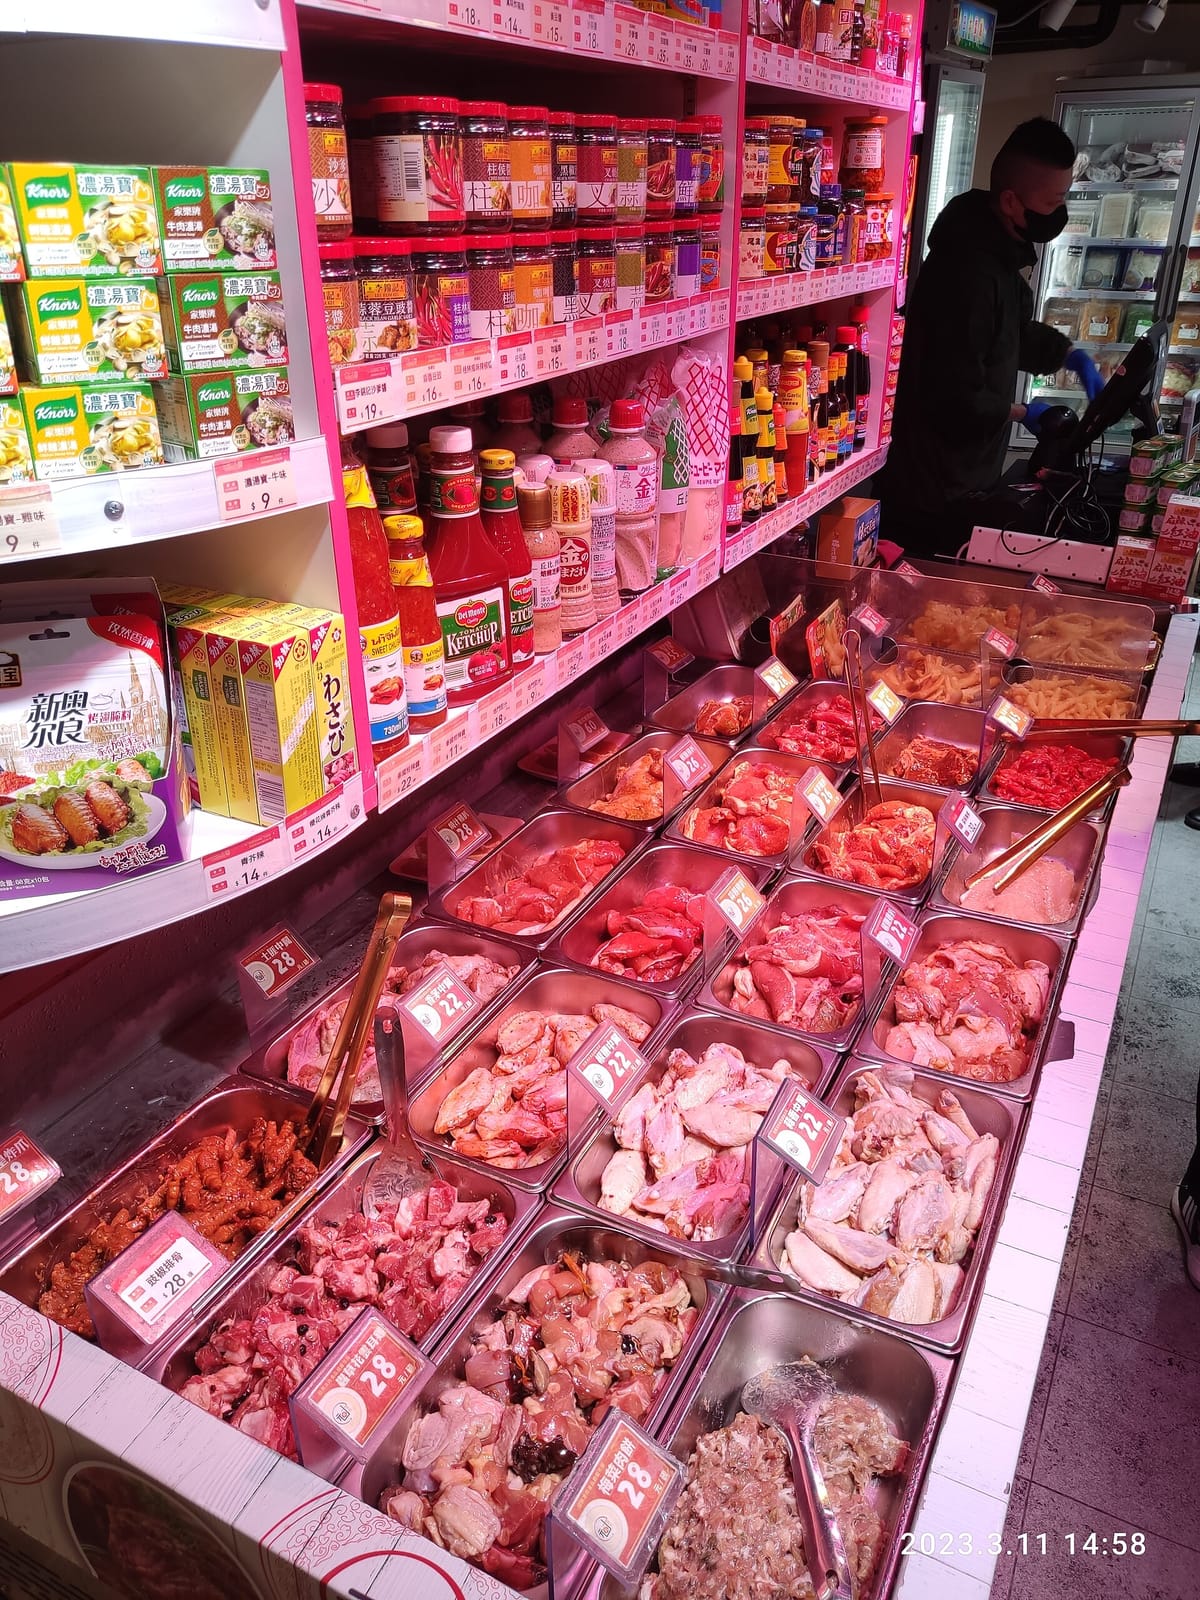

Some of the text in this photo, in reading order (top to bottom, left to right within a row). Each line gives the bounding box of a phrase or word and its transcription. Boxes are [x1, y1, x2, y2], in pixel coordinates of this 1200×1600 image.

[465, 7, 476, 24] 18
[508, 17, 518, 34] 14
[26, 182, 71, 199] Knorr
[79, 174, 135, 195] 濃湯寶
[166, 184, 204, 198] Knorr
[210, 175, 256, 194] 濃湯寶
[182, 289, 218, 302] Knorr
[225, 277, 268, 296] 濃湯寶
[38, 297, 80, 312] Knorr
[88, 287, 142, 306] 濃湯寶
[236, 373, 278, 394] 濃湯寶
[472, 376, 482, 391] 16
[84, 393, 138, 413] 濃湯寶
[198, 388, 231, 403] Knorr
[426, 387, 437, 401] 16
[35, 406, 76, 420] Knorr
[364, 403, 377, 420] 19
[634, 477, 652, 500] 金
[261, 492, 270, 510] 9
[6, 534, 19, 553] 9
[560, 538, 589, 564] 金の
[457, 612, 468, 621] Del
[446, 621, 498, 657] KETCHUP
[460, 623, 489, 636] TOMATO
[371, 644, 389, 656] SWEET
[25, 689, 89, 724] 新奥
[323, 673, 347, 757] わさび
[494, 714, 503, 727] 18
[22, 716, 90, 749] 尔良
[686, 759, 699, 773] 26
[401, 777, 412, 792] 22
[317, 825, 332, 842] 14
[456, 821, 473, 841] 28
[241, 868, 260, 885] 14
[890, 919, 908, 940] 22
[271, 951, 296, 975] 28
[438, 992, 464, 1017] 22
[607, 1050, 632, 1078] 22
[798, 1112, 824, 1142] 22
[0, 1161, 30, 1195] 28
[145, 1250, 184, 1287] 豉椒排骨
[164, 1273, 187, 1296] 28
[359, 1353, 397, 1398] 28
[597, 1436, 637, 1497] 梅菜肉餅
[617, 1460, 653, 1510] 28
